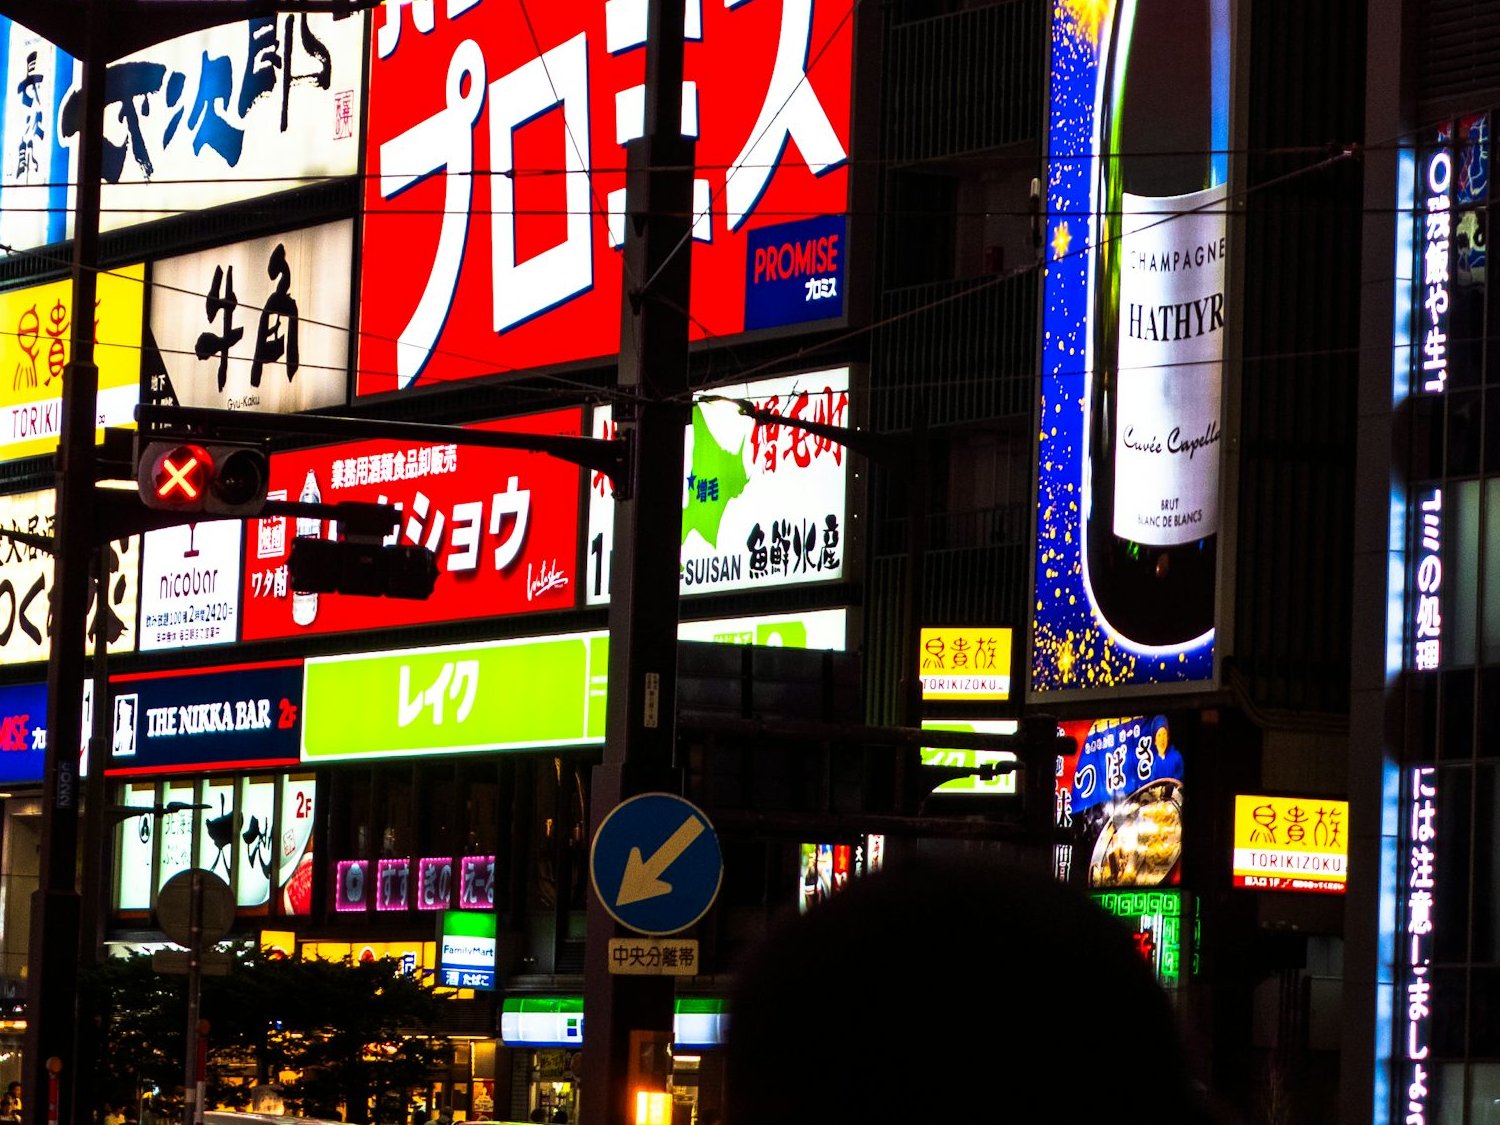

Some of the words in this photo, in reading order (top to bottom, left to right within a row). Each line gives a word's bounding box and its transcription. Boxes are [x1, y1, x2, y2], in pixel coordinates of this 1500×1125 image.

[17, 51, 45, 184] 長次郎
[754, 235, 839, 284] PROMISE
[1130, 237, 1226, 273] CHAMPAGNE
[195, 243, 299, 392] 牛角
[1129, 292, 1225, 342] HATHYR
[1160, 498, 1179, 512] BRUT
[160, 567, 218, 600] nicobar
[398, 660, 479, 727] レイク
[922, 678, 997, 691] TORIKIZOKU
[146, 707, 178, 737] THE
[178, 700, 235, 735] NIKKA
[235, 698, 272, 731] BAR
[295, 792, 312, 819] 2F
[1250, 852, 1341, 872] TORIKIZOKU
[443, 944, 494, 958] FamilyMart
[612, 946, 695, 968] 中央分離帯
